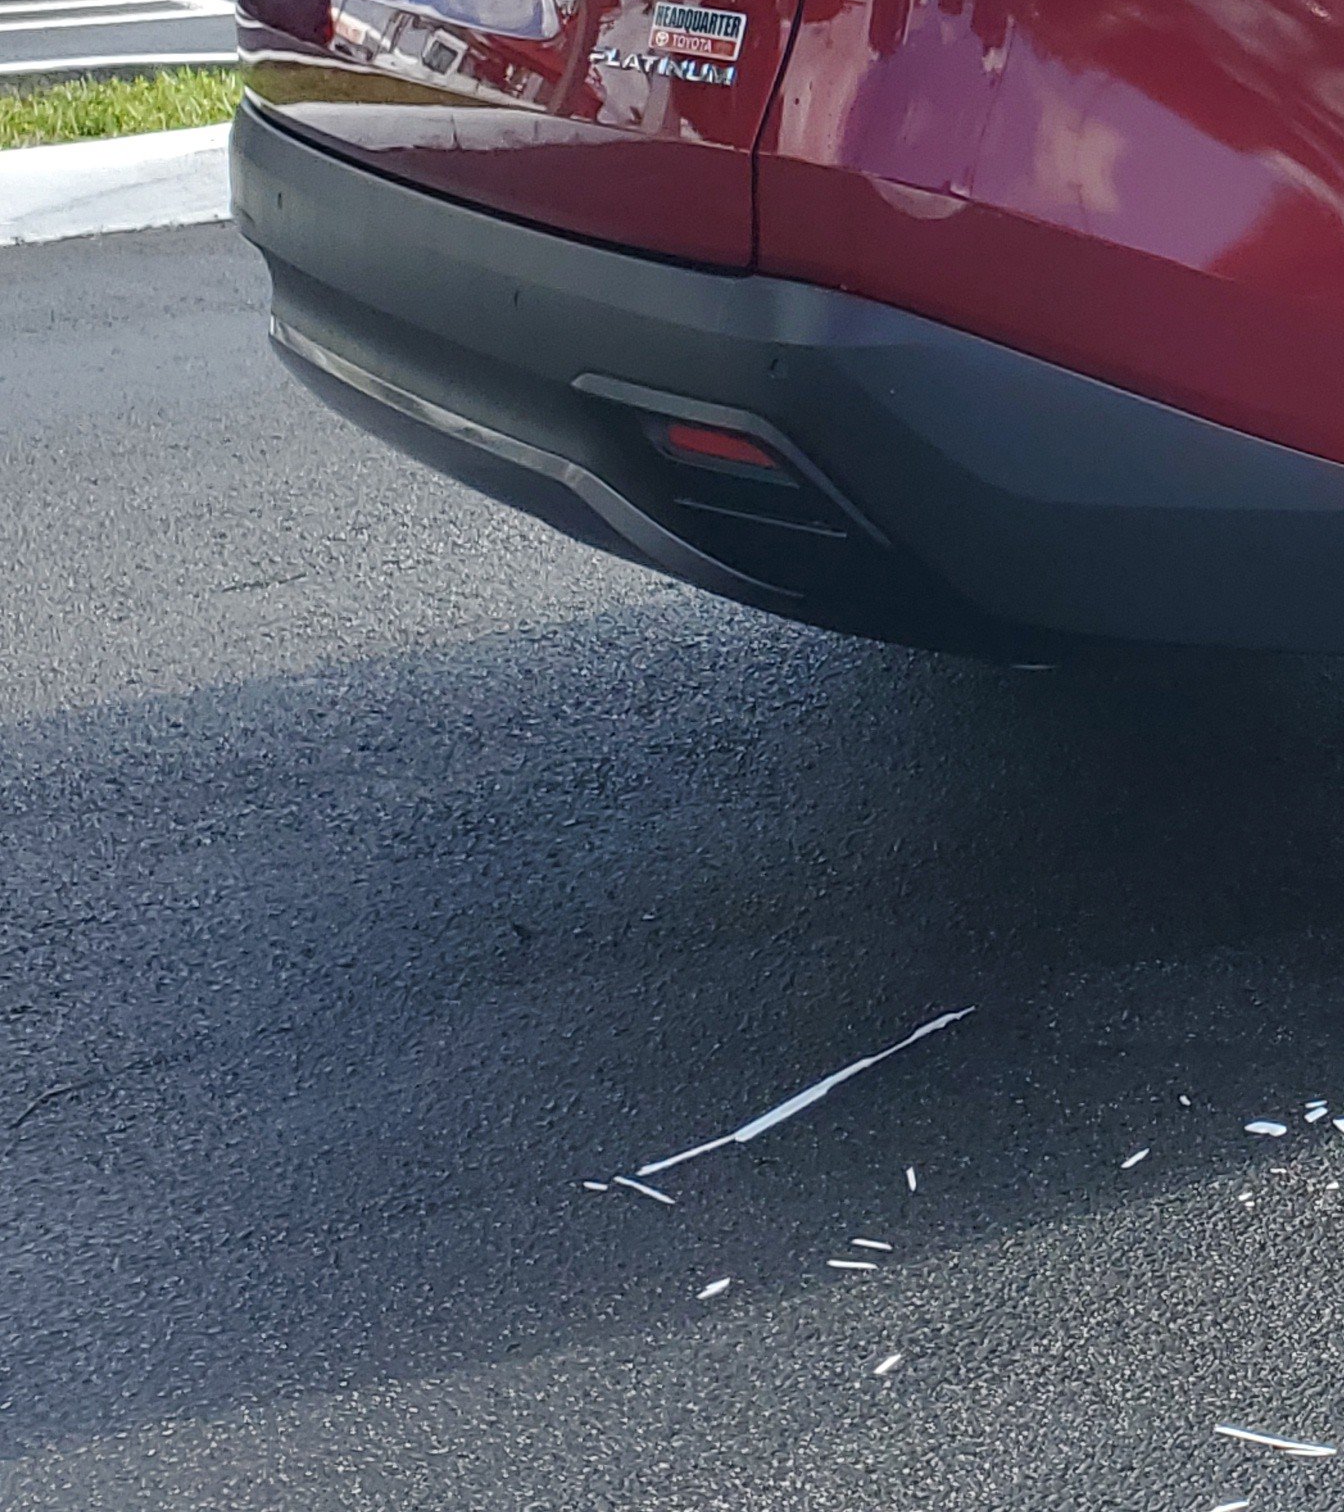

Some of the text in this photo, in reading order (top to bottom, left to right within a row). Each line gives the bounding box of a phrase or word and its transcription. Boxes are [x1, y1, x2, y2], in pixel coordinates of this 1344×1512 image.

[655, 5, 742, 38] HEADQUARTER
[672, 35, 712, 53] TOYOTA
[589, 48, 736, 86] PLATINUM
